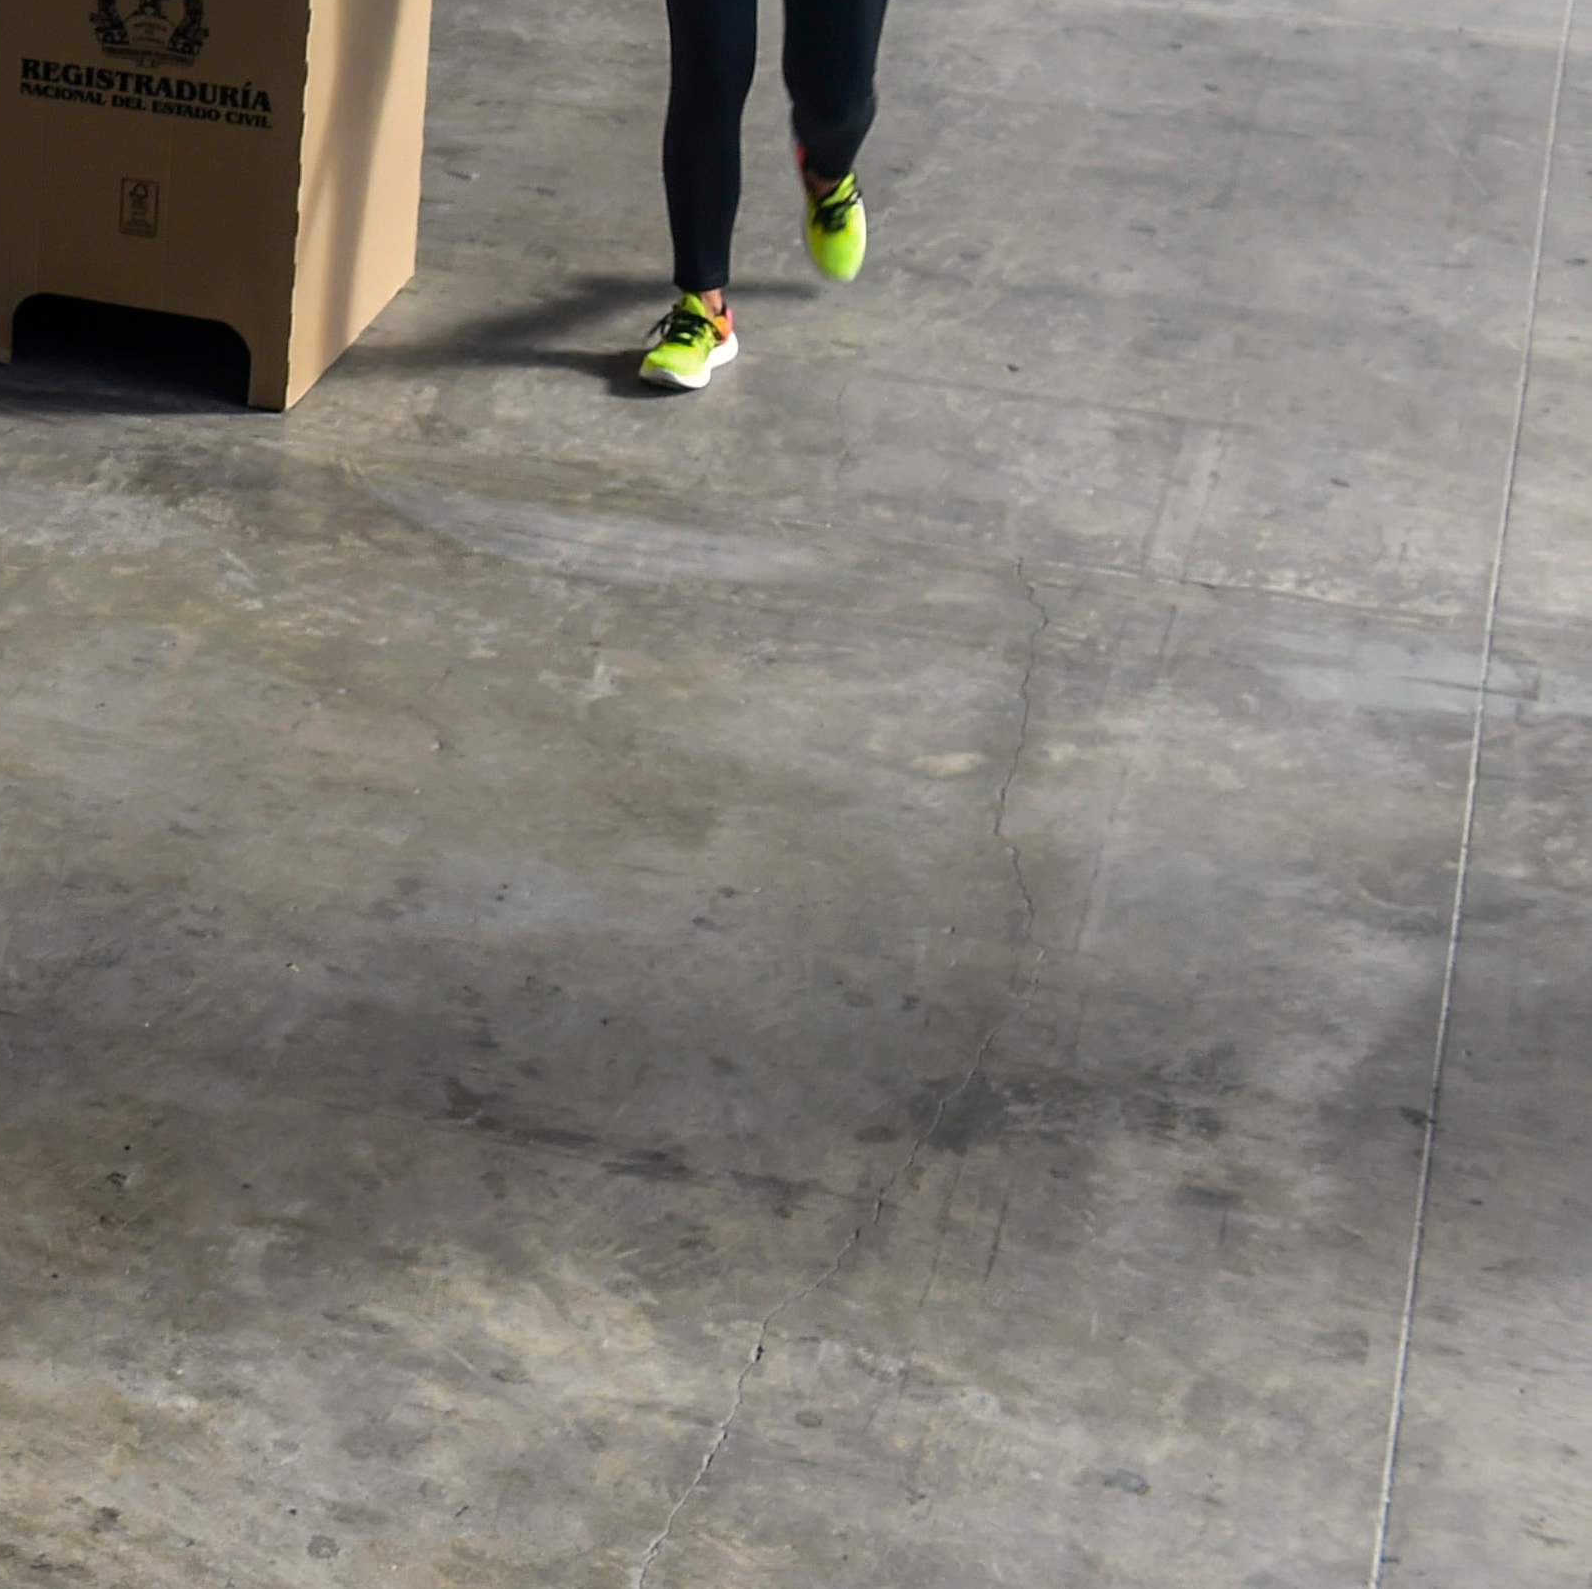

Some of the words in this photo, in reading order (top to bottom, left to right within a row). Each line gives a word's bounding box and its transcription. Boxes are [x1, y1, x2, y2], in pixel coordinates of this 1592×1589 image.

[20, 58, 272, 112] REGISTRADURÍA
[20, 82, 105, 106] NACIONAL
[112, 94, 145, 111] DEL
[152, 101, 220, 122] ESTADO
[225, 110, 273, 129] CIVIL
